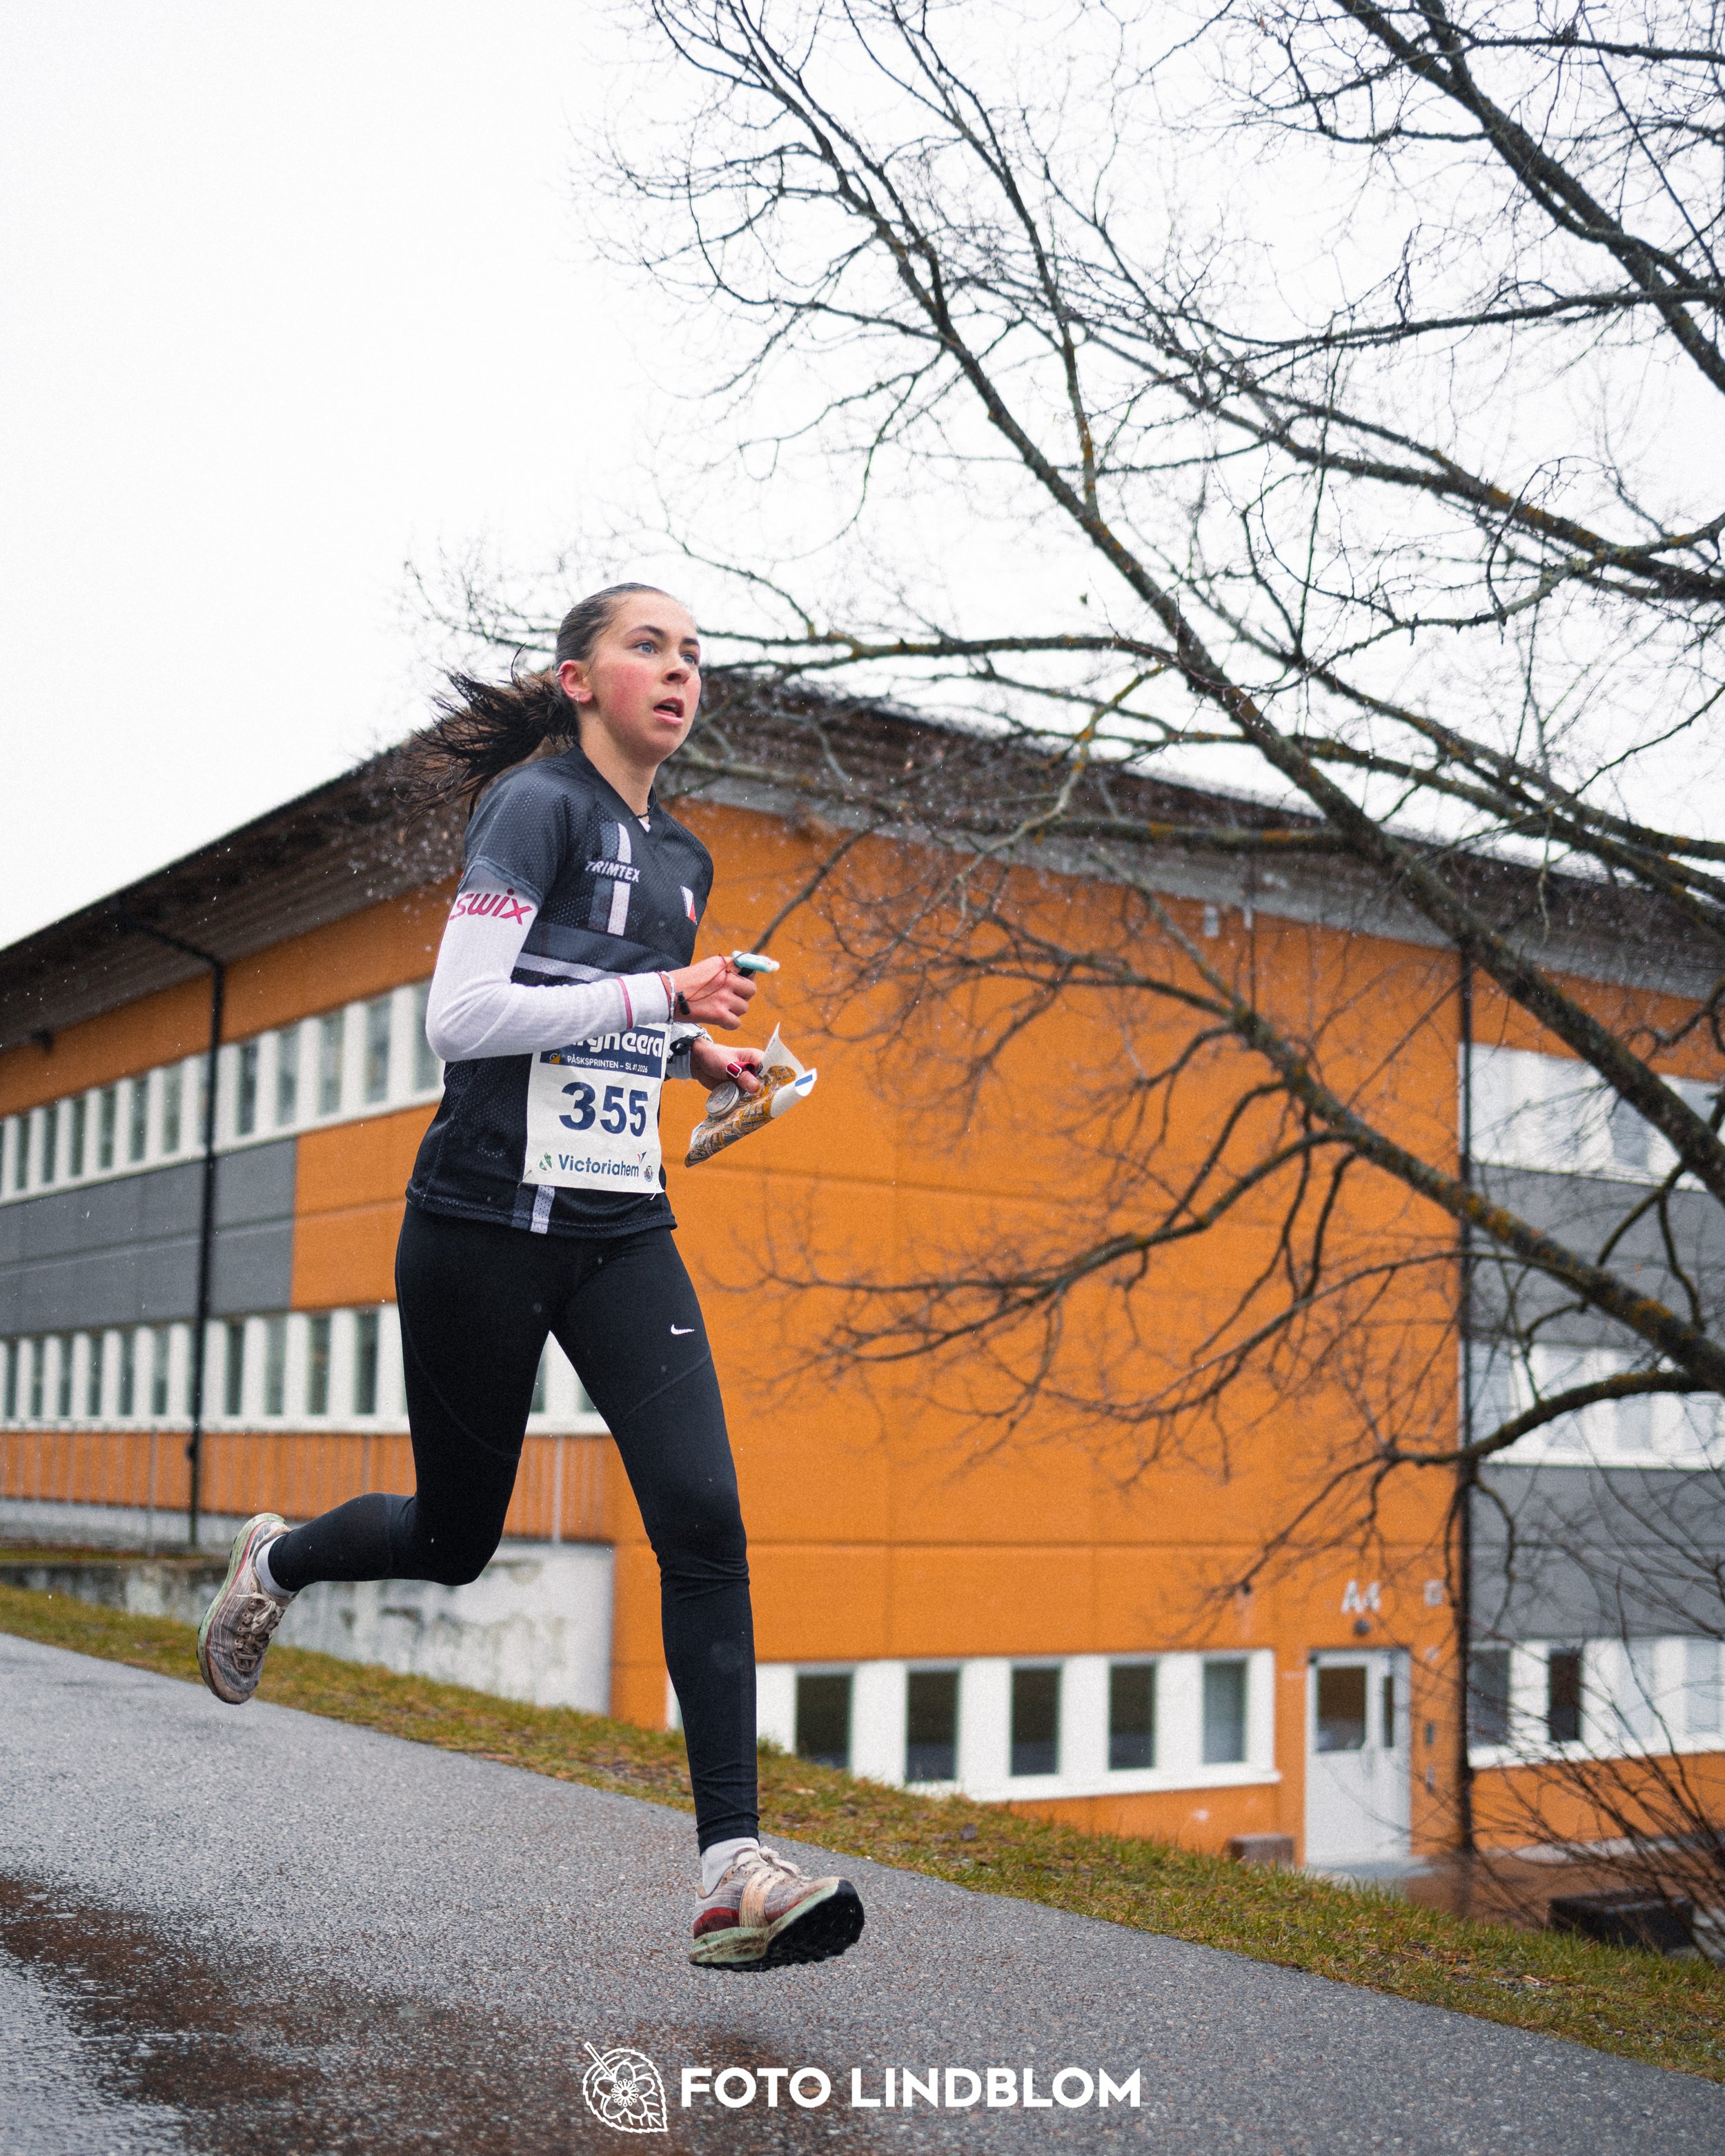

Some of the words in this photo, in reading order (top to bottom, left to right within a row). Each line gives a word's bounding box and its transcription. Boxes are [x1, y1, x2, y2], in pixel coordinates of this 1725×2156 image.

[584, 861, 641, 882] TRIMTEX
[567, 1054, 619, 1069] PÅSKSPRINTEN
[638, 1065, 648, 1074] 2026
[558, 1082, 649, 1137] 355
[558, 1154, 639, 1177] Victoriahem
